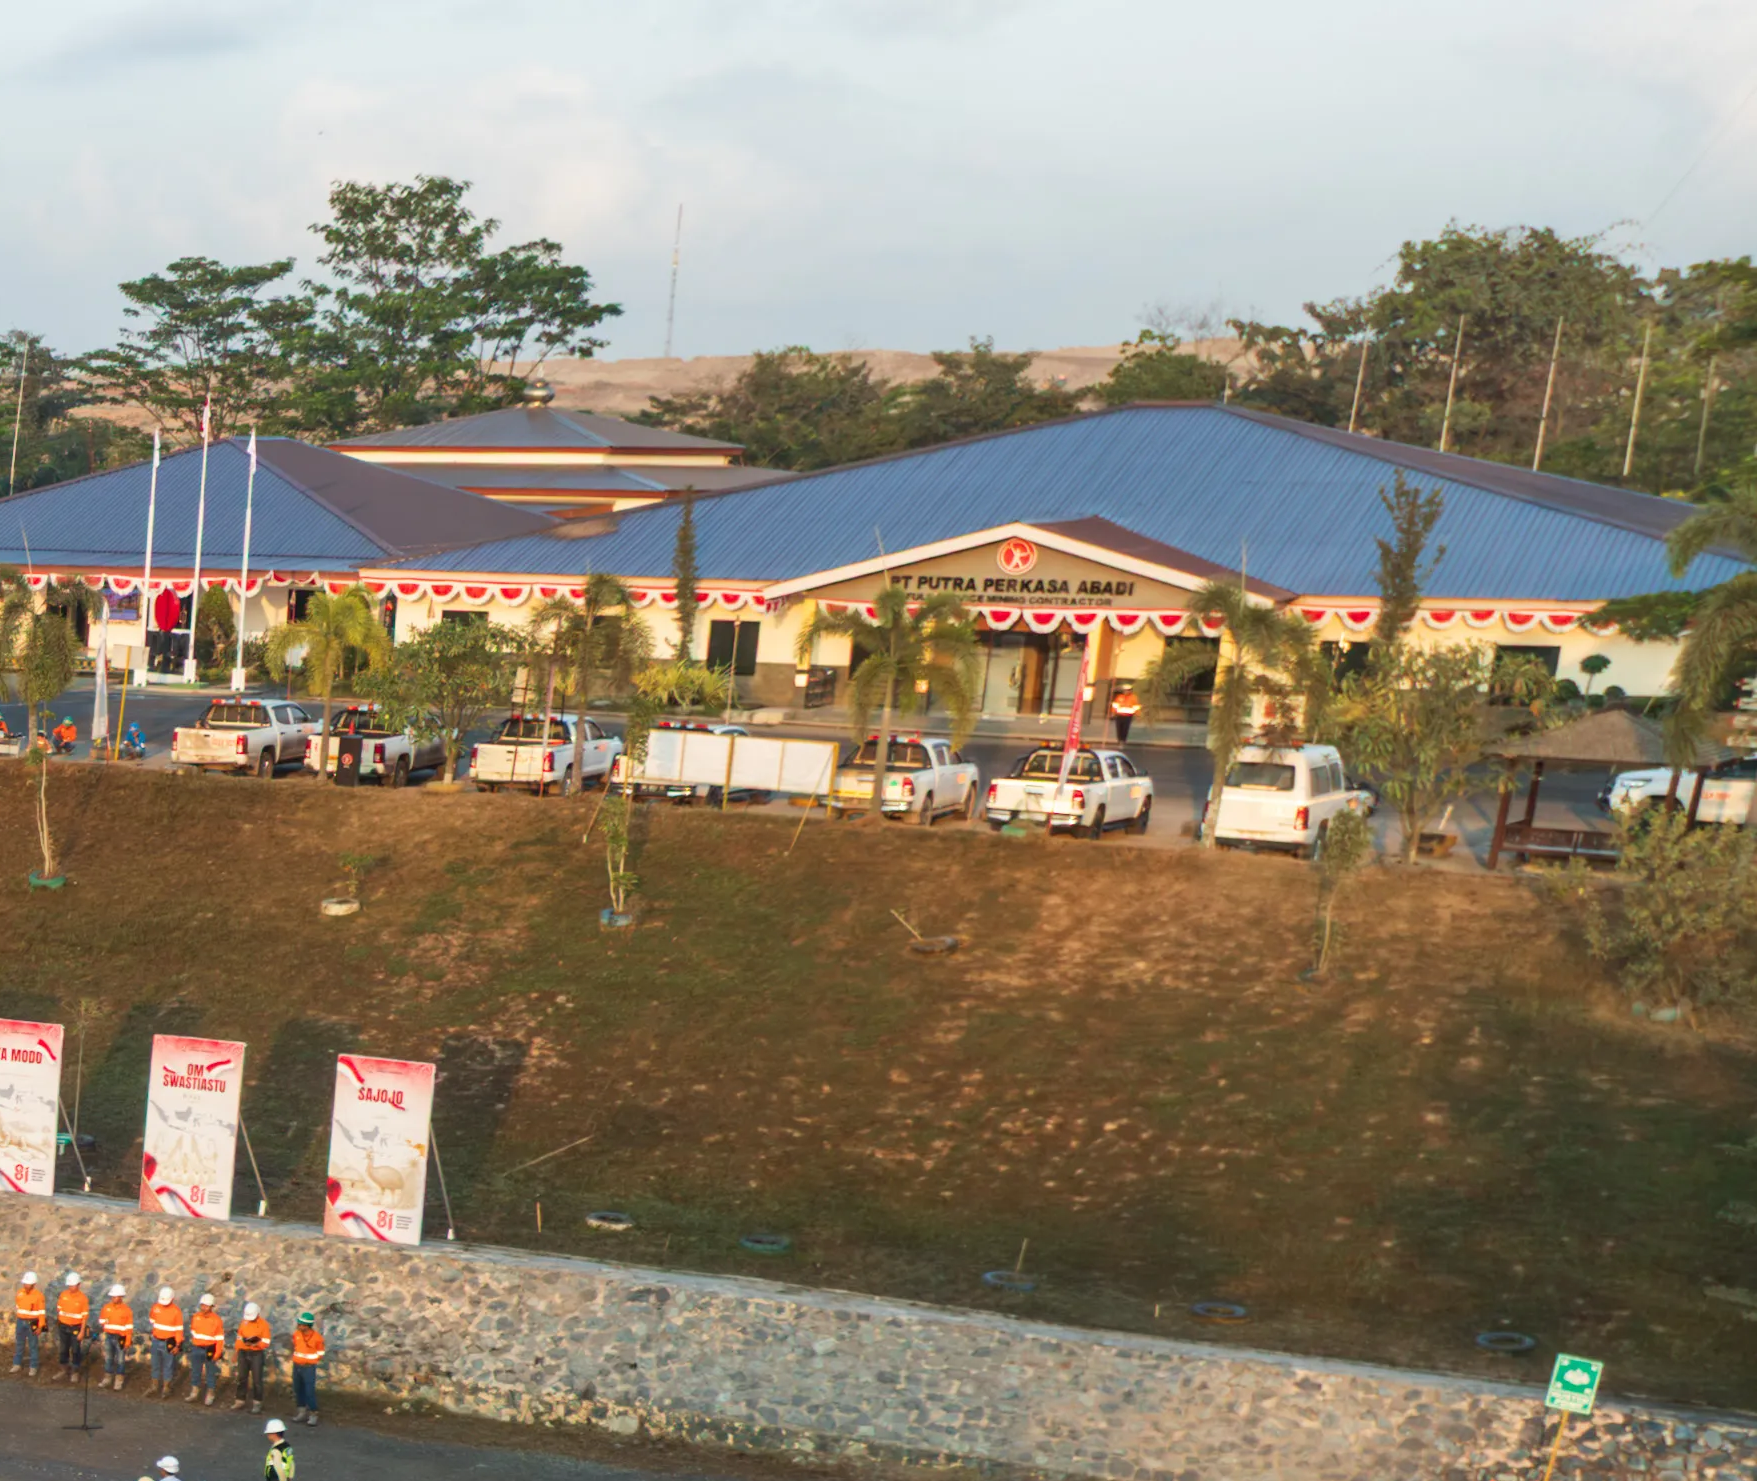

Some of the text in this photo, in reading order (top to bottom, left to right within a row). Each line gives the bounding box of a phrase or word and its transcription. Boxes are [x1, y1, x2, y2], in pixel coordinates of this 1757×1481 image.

[890, 575, 1135, 597] PT PUTRA PERKASA ABADI
[1028, 595, 1114, 607] CONTRACTOR
[11, 1048, 43, 1065] MODO
[187, 1063, 205, 1077] OM
[163, 1074, 226, 1093] SWASTIASTU
[357, 1087, 404, 1106] SAJOJO
